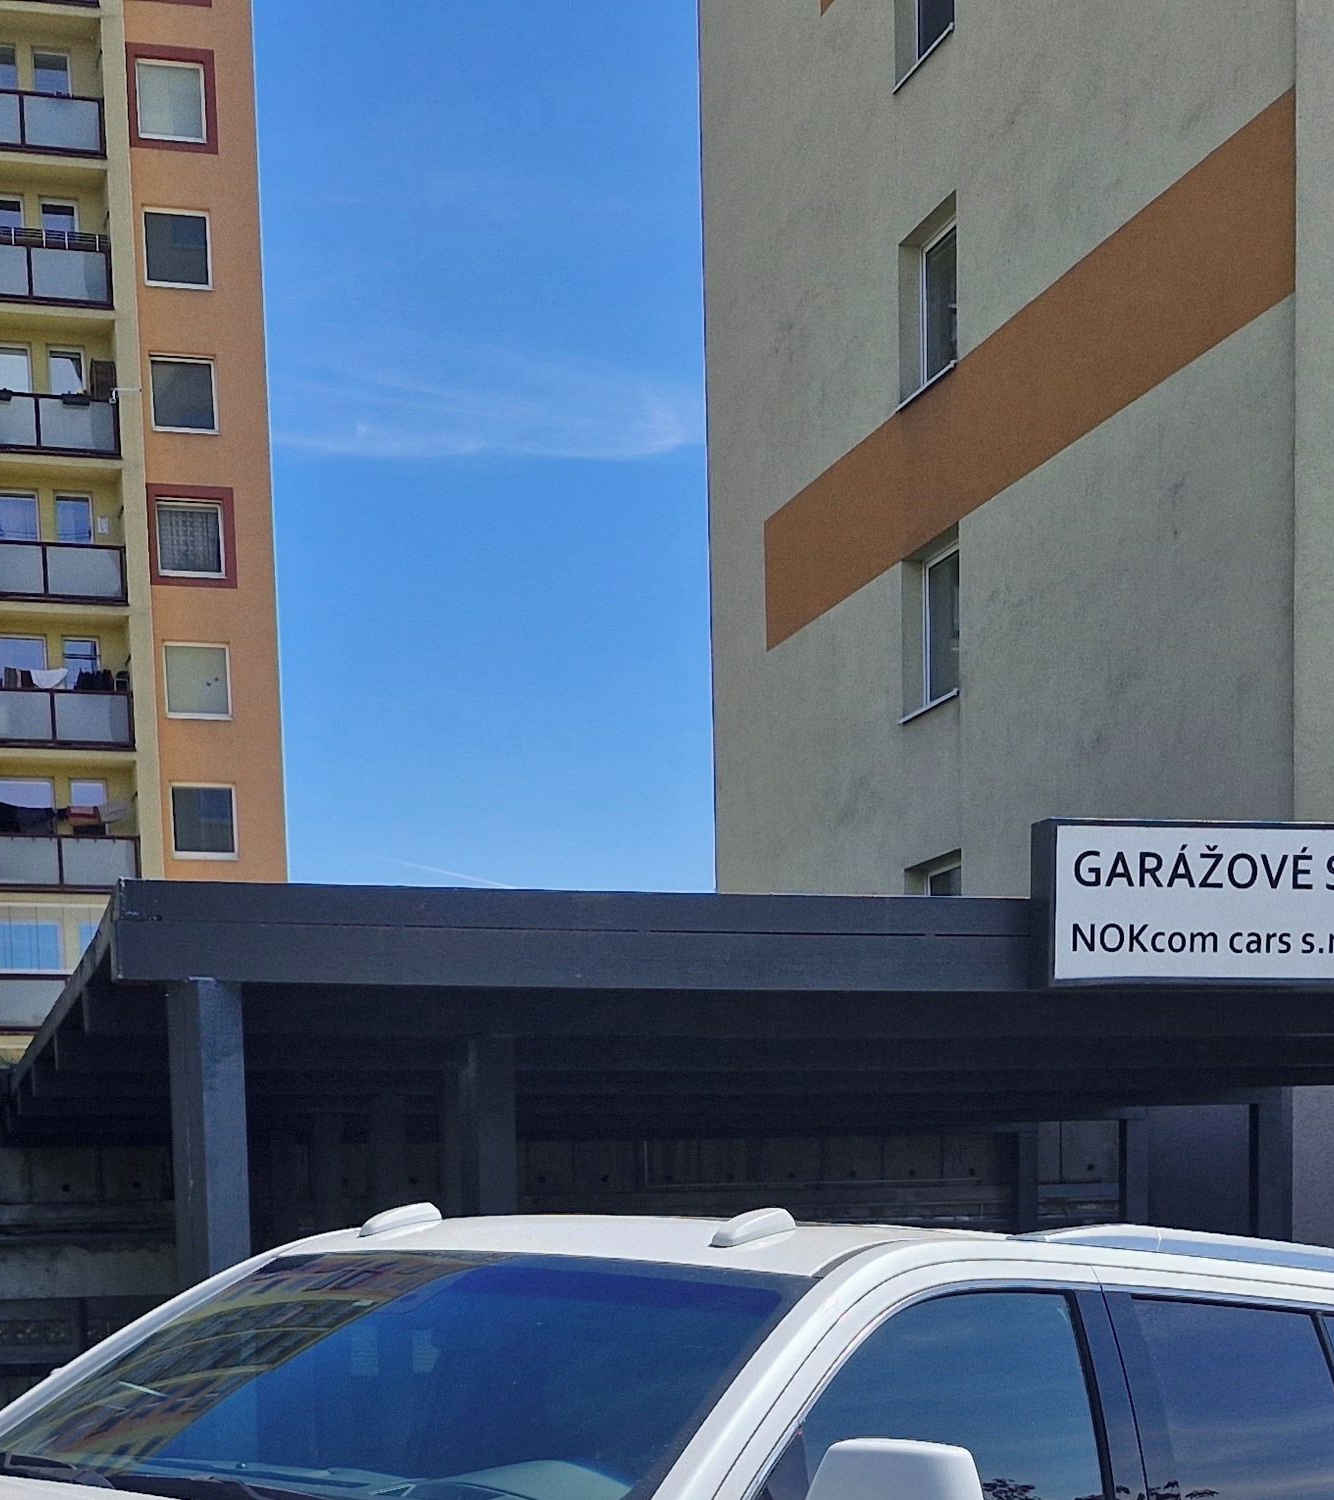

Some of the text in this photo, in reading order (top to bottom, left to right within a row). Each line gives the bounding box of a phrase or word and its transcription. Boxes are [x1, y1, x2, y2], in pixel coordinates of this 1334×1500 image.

[1074, 844, 1313, 890] GARÁŽOVÉ
[1071, 922, 1218, 953] NOKcom
[1228, 931, 1292, 954] cars
